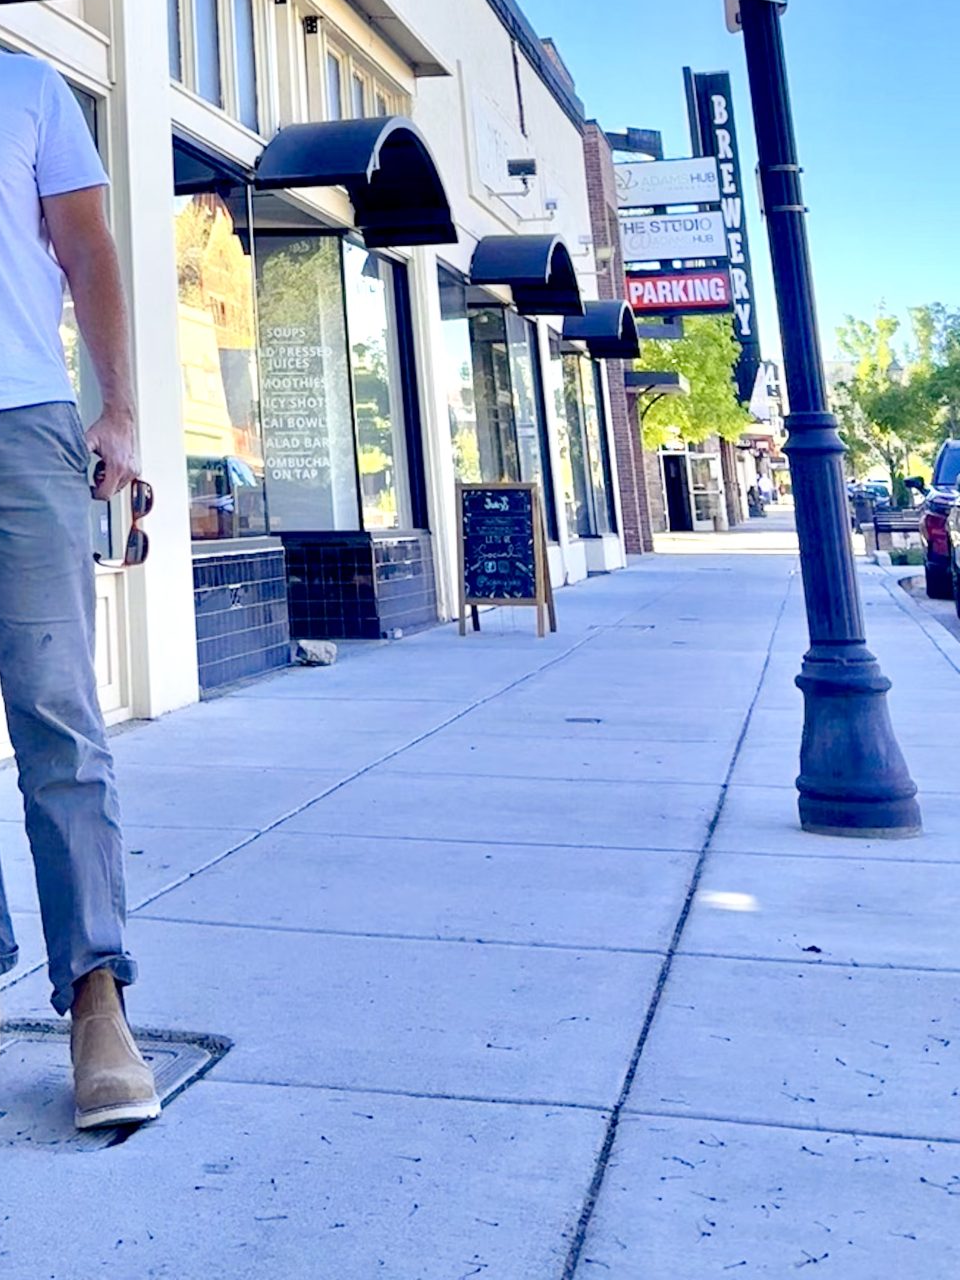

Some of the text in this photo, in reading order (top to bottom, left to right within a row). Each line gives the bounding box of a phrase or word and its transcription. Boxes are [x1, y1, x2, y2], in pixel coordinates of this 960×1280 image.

[689, 171, 716, 184] HUB
[711, 94, 751, 336] BREWERY
[620, 217, 713, 235] HE STUDIO
[692, 233, 715, 244] HUB
[629, 277, 727, 305] PARKING
[266, 327, 306, 338] SOUPS
[279, 346, 333, 357] PRESSED
[268, 358, 310, 371] JUICES
[262, 377, 329, 389] MOOTHIES
[263, 417, 283, 428] CAI
[266, 437, 300, 449] ALAD
[266, 457, 331, 469] OMBUCHA
[272, 468, 319, 480] ON TAP
